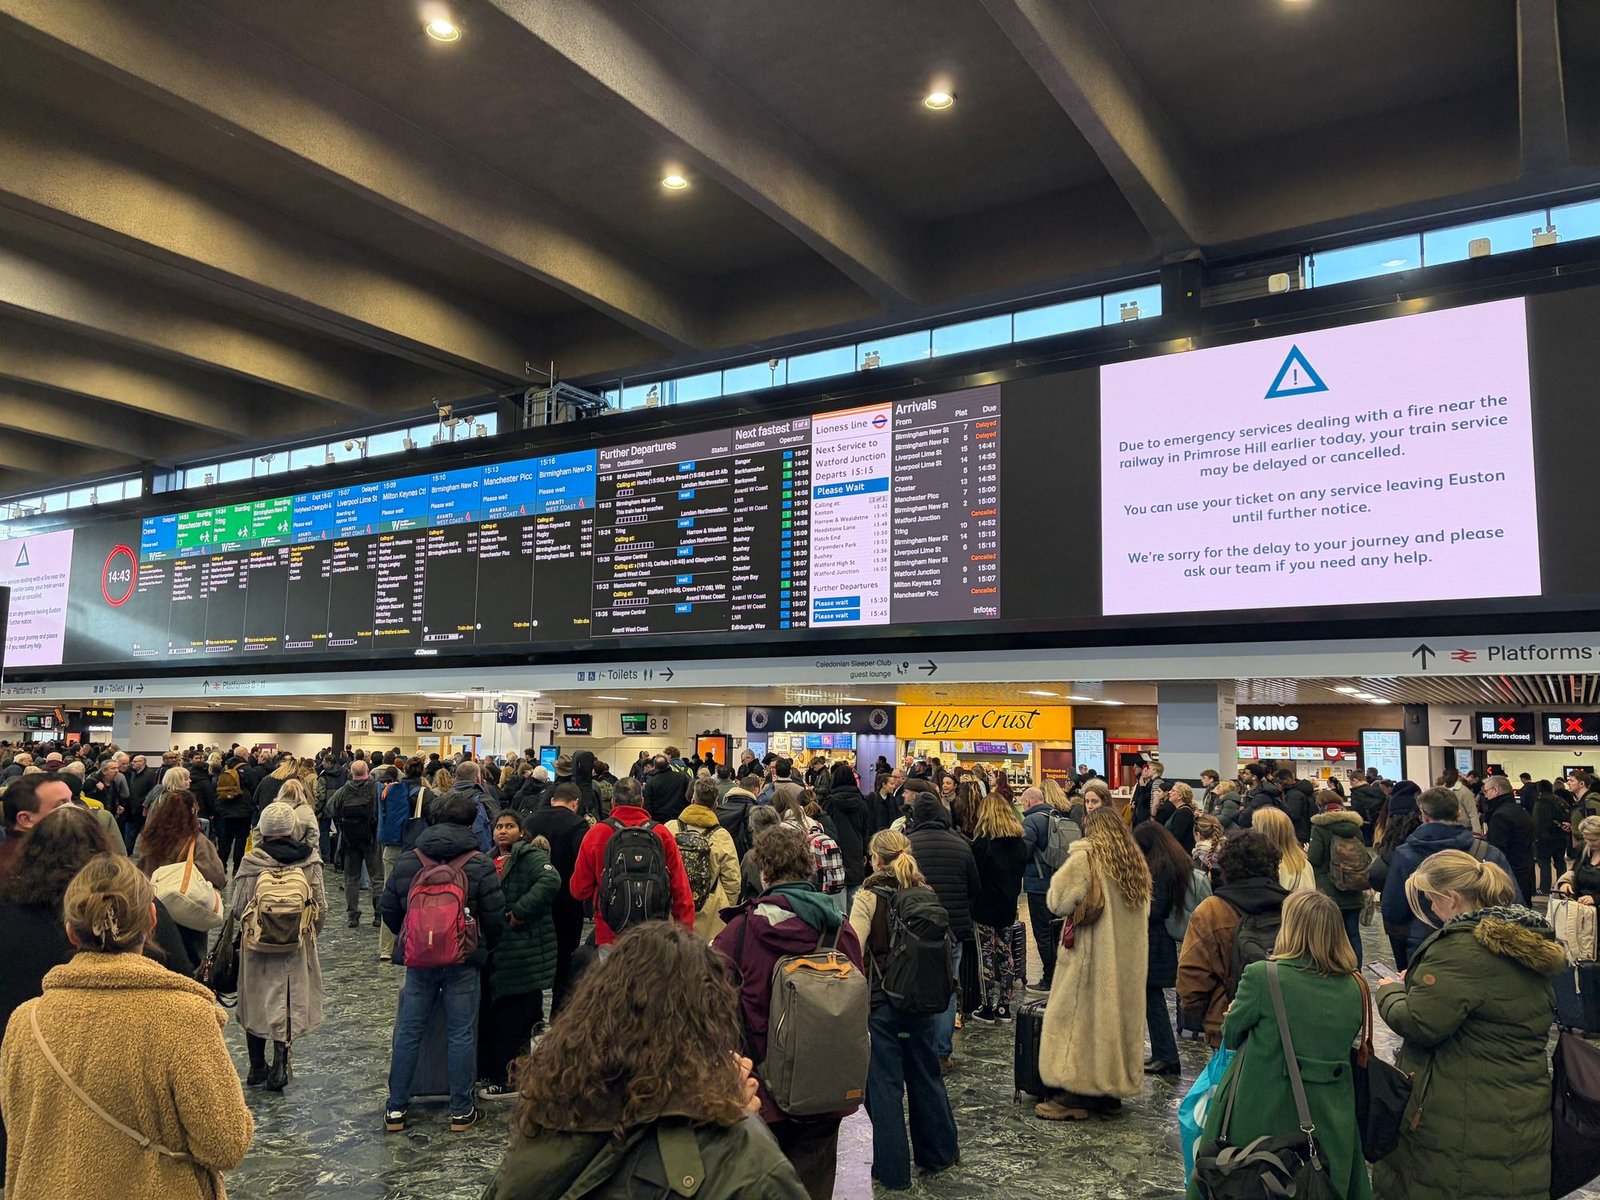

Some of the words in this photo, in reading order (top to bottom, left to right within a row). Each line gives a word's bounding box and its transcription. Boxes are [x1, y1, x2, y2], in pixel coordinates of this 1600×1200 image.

[895, 398, 936, 414] Arrivals
[816, 423, 848, 434] Lioness
[851, 420, 867, 429] line
[1119, 441, 1143, 452] Due
[1147, 439, 1160, 448] to
[1164, 430, 1235, 446] emergency
[1239, 423, 1292, 437] services
[1296, 416, 1349, 430] dealing
[1354, 409, 1387, 423] with
[1393, 409, 1402, 418] a
[1407, 404, 1433, 416] fire
[1439, 400, 1475, 413] near
[1480, 394, 1507, 407] the
[735, 428, 756, 439] Next
[758, 422, 789, 436] fastest
[895, 430, 928, 440] Birmingham
[735, 441, 764, 449] Destination
[779, 435, 804, 444] Operator
[1120, 456, 1164, 468] railway
[1168, 452, 1179, 462] in
[1184, 447, 1240, 461] Primrose
[1244, 441, 1266, 454] Hill
[1271, 437, 1316, 451] earlier
[1320, 432, 1365, 445] today,
[1370, 428, 1404, 443] your
[1409, 421, 1445, 435] train
[1451, 415, 1507, 430] service
[600, 448, 629, 460] Further
[631, 441, 676, 456] Departures
[815, 446, 834, 454] Next
[837, 442, 866, 451] Service
[540, 457, 555, 465] 15:16
[815, 456, 848, 467] Watford
[850, 452, 885, 463] Junction
[895, 452, 920, 461] Liverpool
[1200, 466, 1228, 477] may
[1232, 462, 1248, 473] be
[1253, 454, 1306, 471] delayed
[1311, 455, 1326, 464] or
[1330, 444, 1404, 462] cancelled.
[539, 468, 571, 478] Birmingham
[815, 470, 846, 480] Departs
[851, 465, 873, 475] 15:15
[484, 475, 518, 485] Manchester
[399, 489, 418, 498] Keynes
[817, 486, 843, 495] Please
[845, 483, 864, 492] Wait
[1124, 504, 1146, 515] You
[1150, 503, 1172, 513] can
[1177, 501, 1198, 510] use
[1202, 498, 1232, 511] your
[1235, 492, 1273, 505] ticket
[1278, 492, 1295, 501] on
[1300, 489, 1326, 501] any
[1330, 482, 1381, 496] service
[1386, 477, 1442, 491] leaving
[1449, 472, 1504, 485] Euston
[337, 499, 359, 507] Liverpool
[1232, 509, 1262, 523] until
[1267, 506, 1316, 520] further
[1321, 502, 1370, 515] notice.
[1128, 551, 1164, 563] We're
[1168, 550, 1200, 562] sorry
[1204, 546, 1222, 558] for
[1226, 545, 1248, 556] the
[1253, 542, 1290, 555] delay
[1295, 541, 1309, 551] to
[1314, 540, 1346, 553] your
[1349, 535, 1409, 551] journey
[1415, 529, 1444, 543] and
[1450, 528, 1503, 544] please
[1184, 565, 1205, 577] ask
[1209, 566, 1231, 575] our
[1235, 563, 1270, 573] team
[1276, 559, 1285, 571] if
[1289, 560, 1315, 573] you
[1320, 554, 1355, 568] need
[1361, 556, 1388, 568] any
[1394, 550, 1432, 566] help.
[109, 569, 130, 583] 14:43
[839, 582, 878, 590] Departures
[1488, 644, 1592, 660] Platforms
[851, 660, 874, 669] Sleeper
[608, 669, 638, 680] Toilets
[110, 684, 125, 692] Toilets
[223, 681, 250, 689] Platforms
[361, 720, 367, 729] 11
[434, 720, 442, 729] 10
[444, 720, 453, 729] 10
[553, 719, 558, 729] 9
[650, 719, 656, 729] 8
[662, 719, 668, 730] 8
[784, 708, 852, 730] panopolis
[922, 710, 980, 734] Upper
[982, 709, 1040, 729] Crust
[1253, 716, 1299, 731] KING
[1449, 719, 1462, 735] 7
